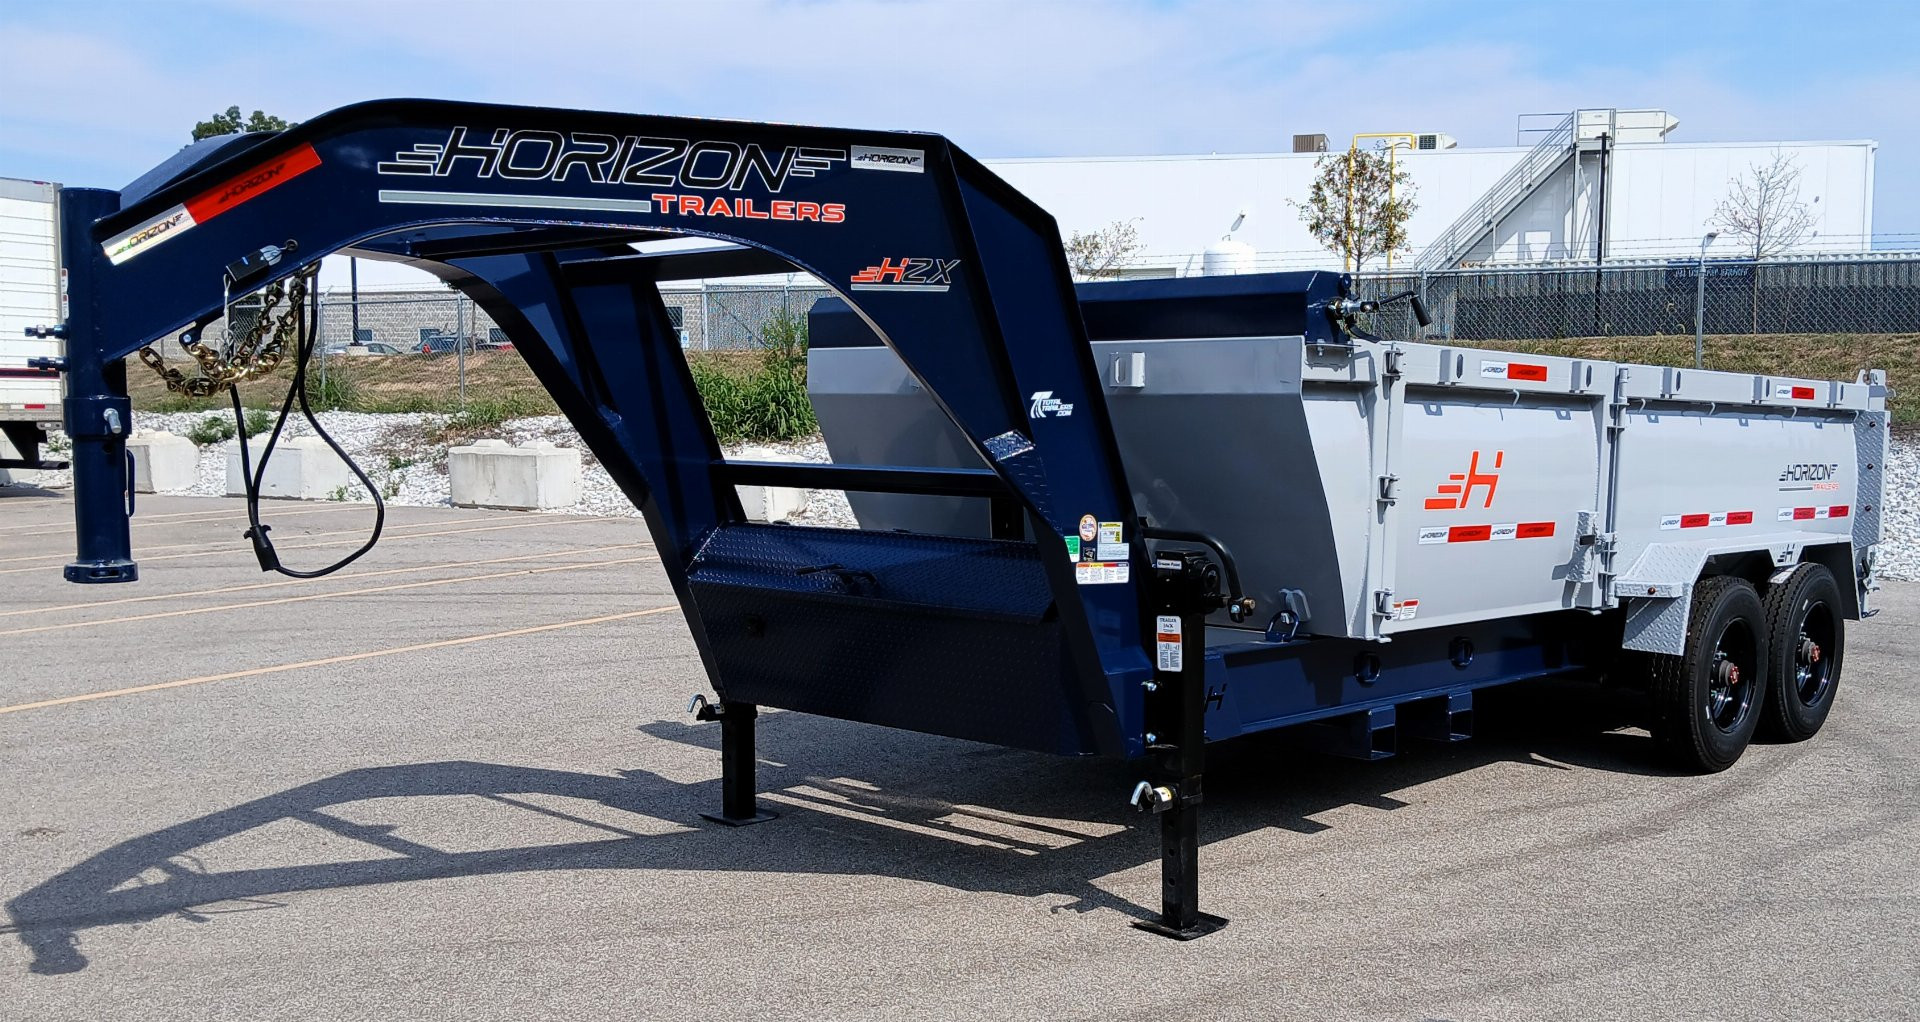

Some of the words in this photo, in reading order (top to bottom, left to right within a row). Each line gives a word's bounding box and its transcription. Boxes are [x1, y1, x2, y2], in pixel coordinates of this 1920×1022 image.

[430, 126, 800, 192] HORIZON
[858, 153, 916, 165] HORIZON
[651, 193, 846, 223] TRAILERS
[1783, 464, 1835, 481] HORIZON
